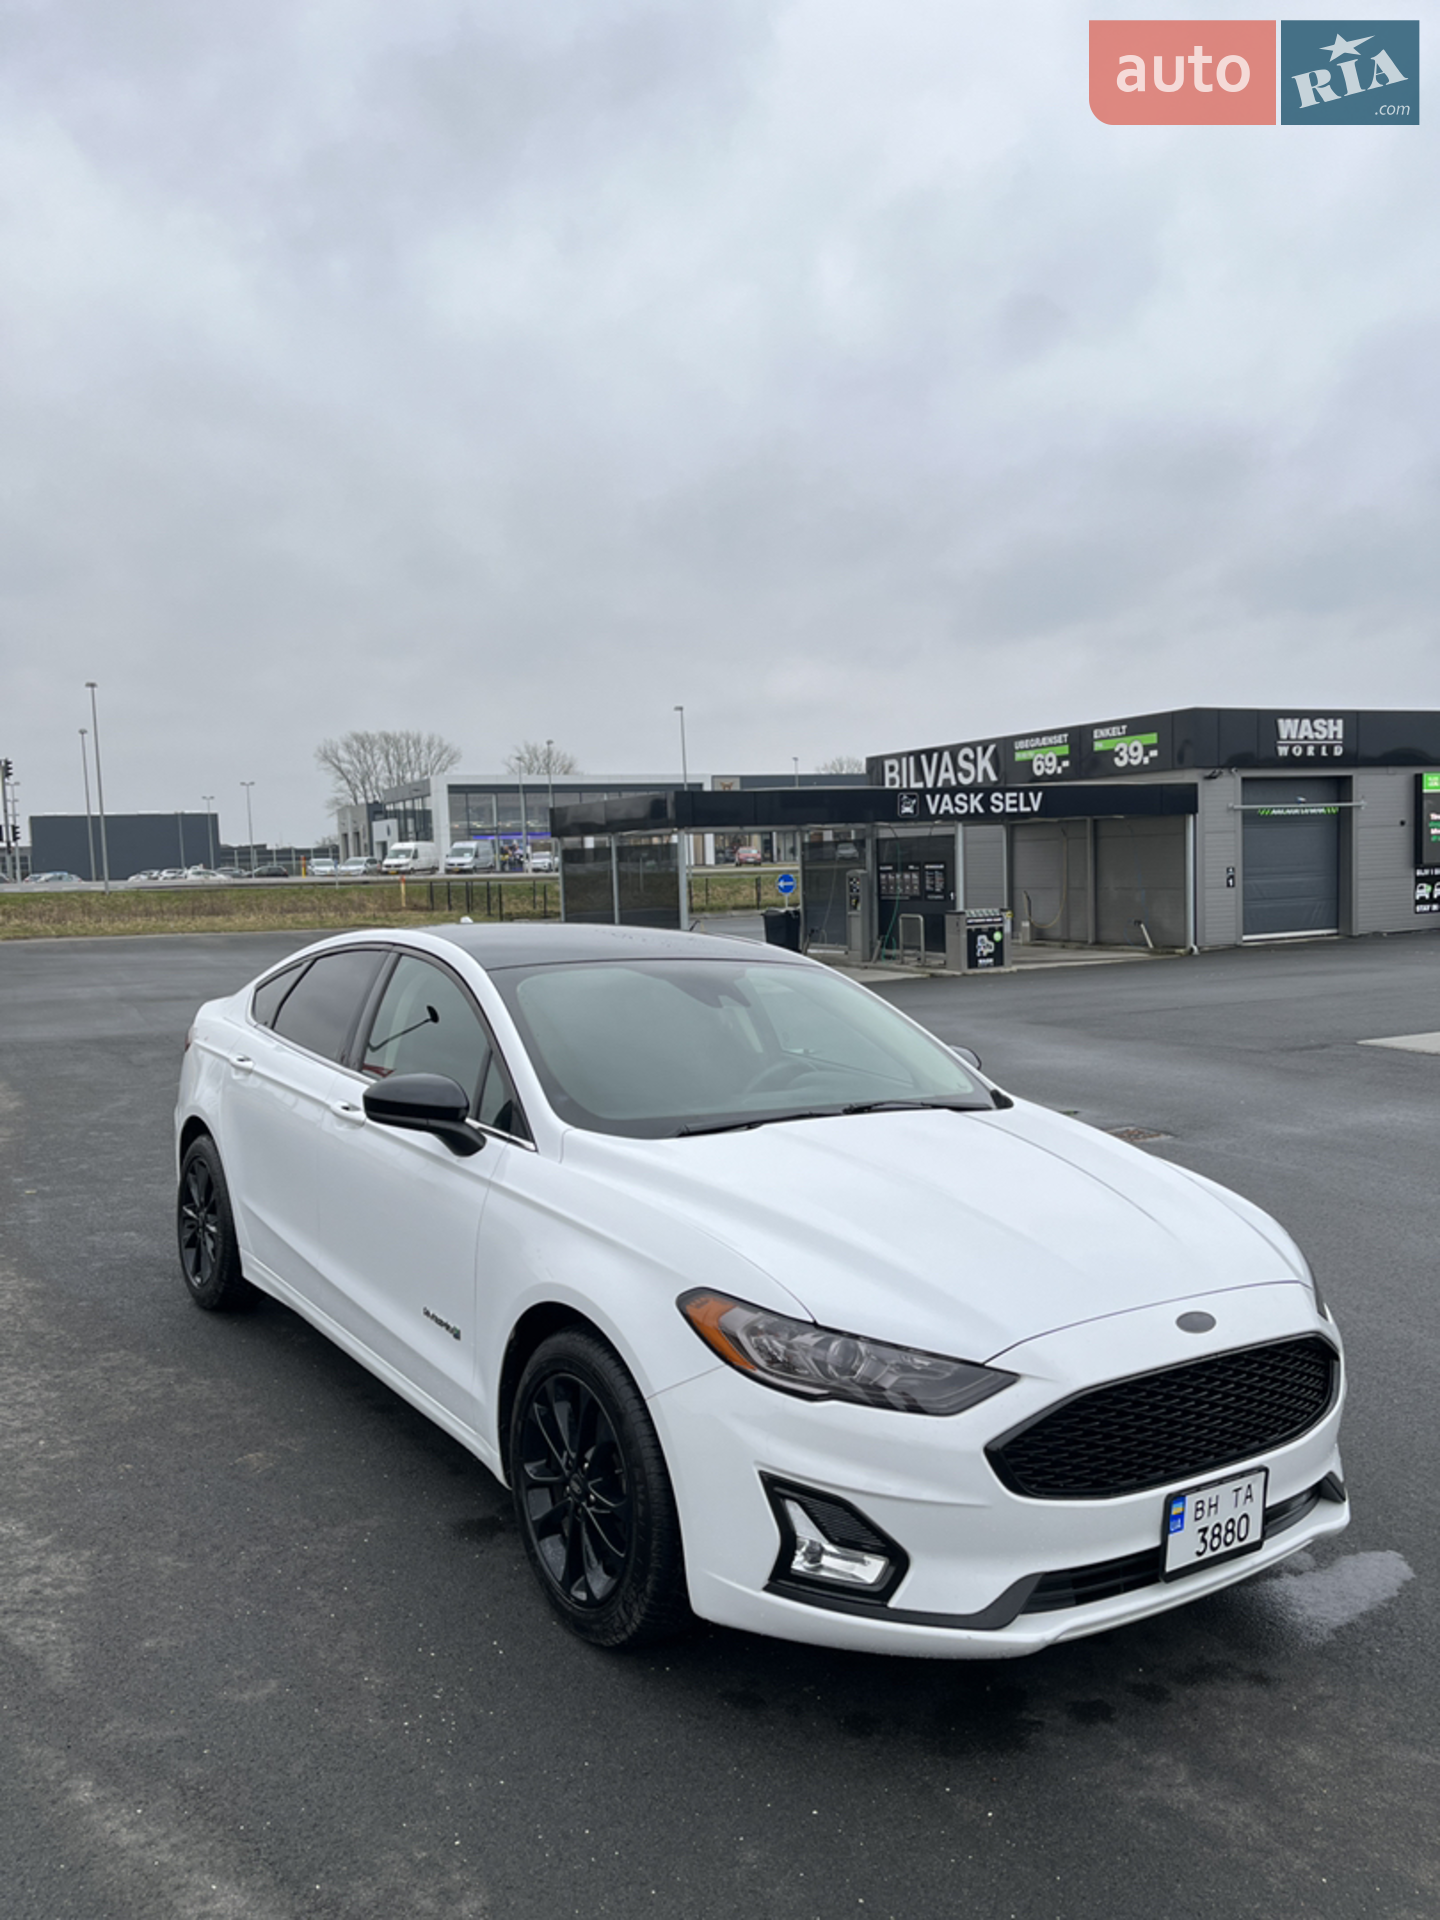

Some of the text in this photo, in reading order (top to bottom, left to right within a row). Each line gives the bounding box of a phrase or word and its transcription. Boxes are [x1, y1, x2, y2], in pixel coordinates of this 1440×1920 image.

[1093, 724, 1128, 739] ENKELT
[1277, 718, 1344, 740] WASH
[1032, 751, 1070, 777] 69.-
[1114, 740, 1158, 768] 39.-
[1277, 745, 1344, 757] WORLD
[884, 744, 999, 788] BILVASK
[926, 791, 1043, 815] VASK SELV
[1194, 1483, 1254, 1522] BH TA
[1195, 1513, 1250, 1557] 3880
